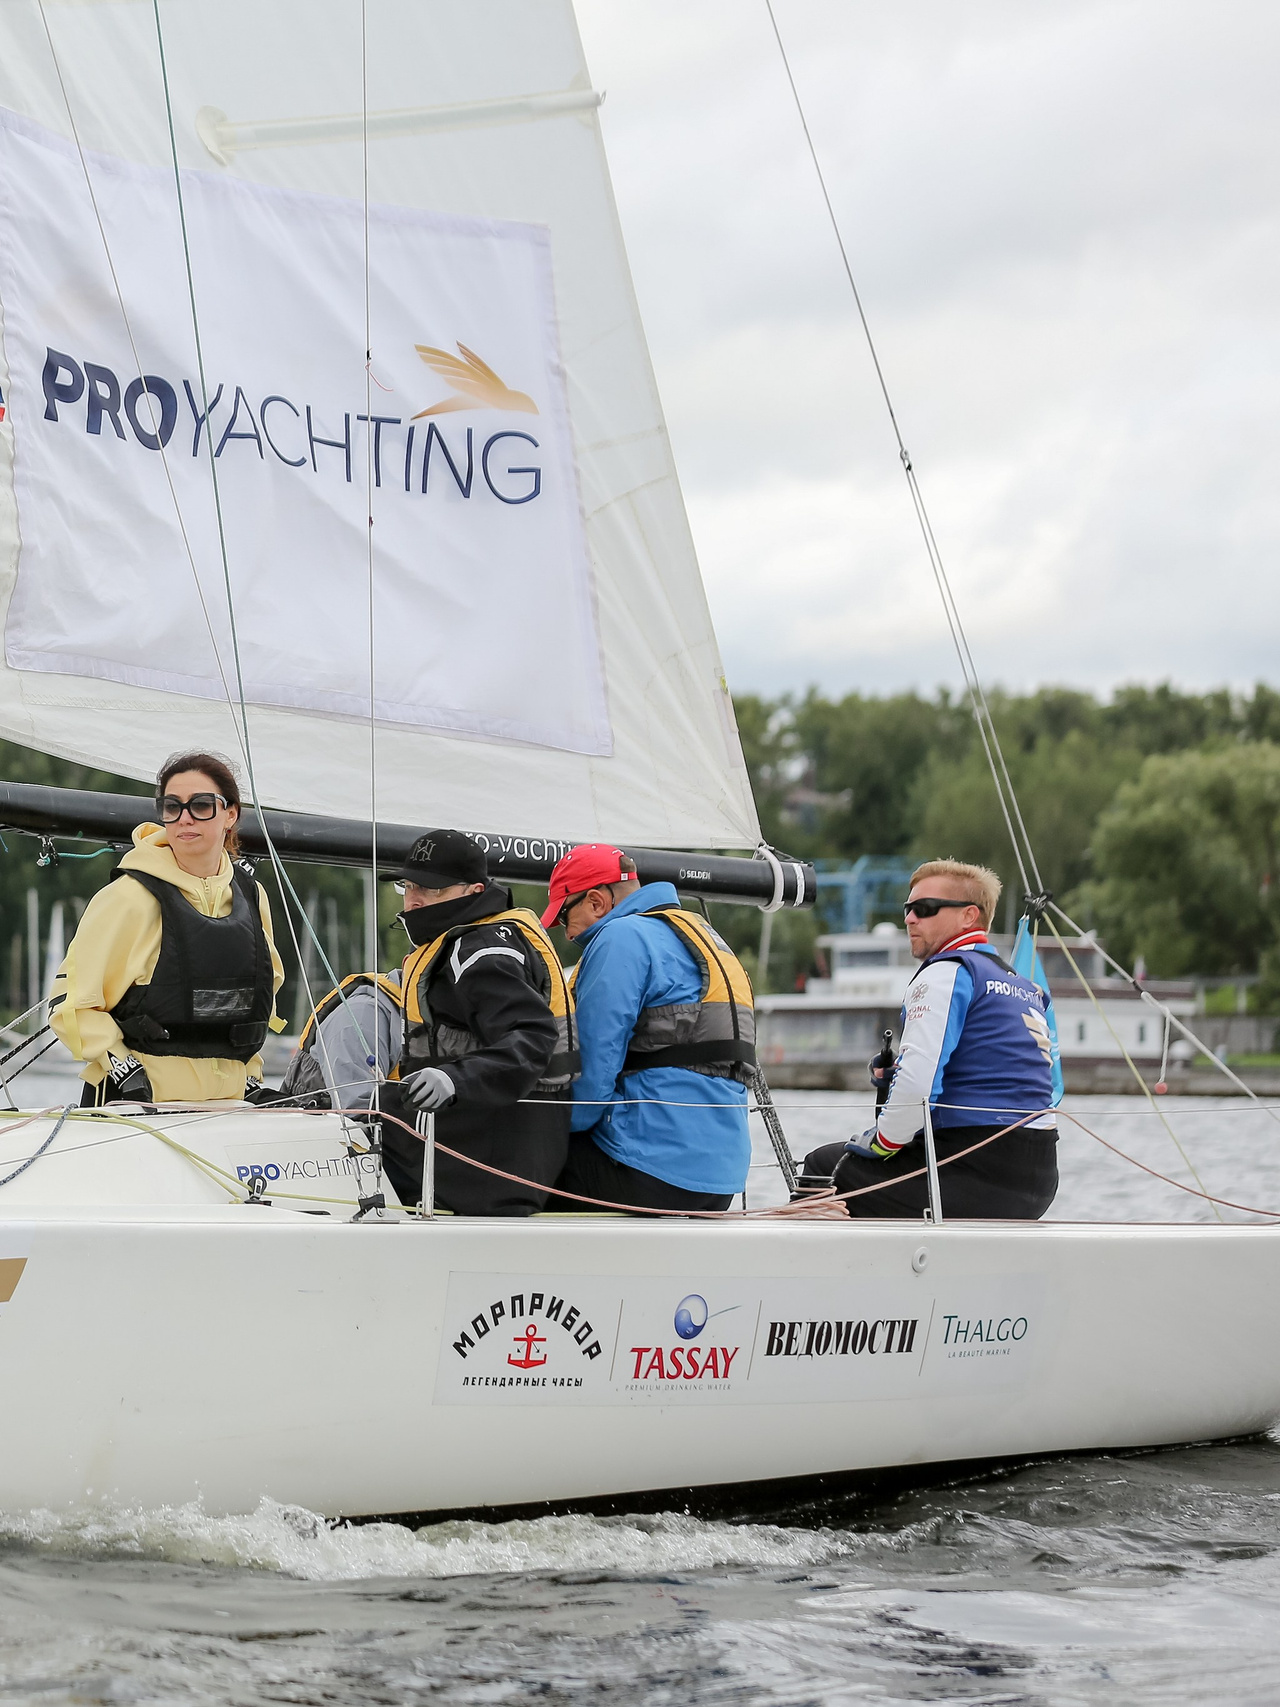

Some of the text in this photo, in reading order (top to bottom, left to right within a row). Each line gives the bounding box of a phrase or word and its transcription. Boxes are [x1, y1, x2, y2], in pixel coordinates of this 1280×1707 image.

[43, 346, 542, 505] PROYACHTING
[452, 1293, 602, 1360] МОРПРИБОР
[763, 1319, 919, 1360] ВЕДОМОСТИ
[942, 1315, 1028, 1344] THALGO
[629, 1347, 740, 1379] TASSAY
[462, 1376, 583, 1387] ЛЕГЕНДАРНЫЕ ЧАСЫ
